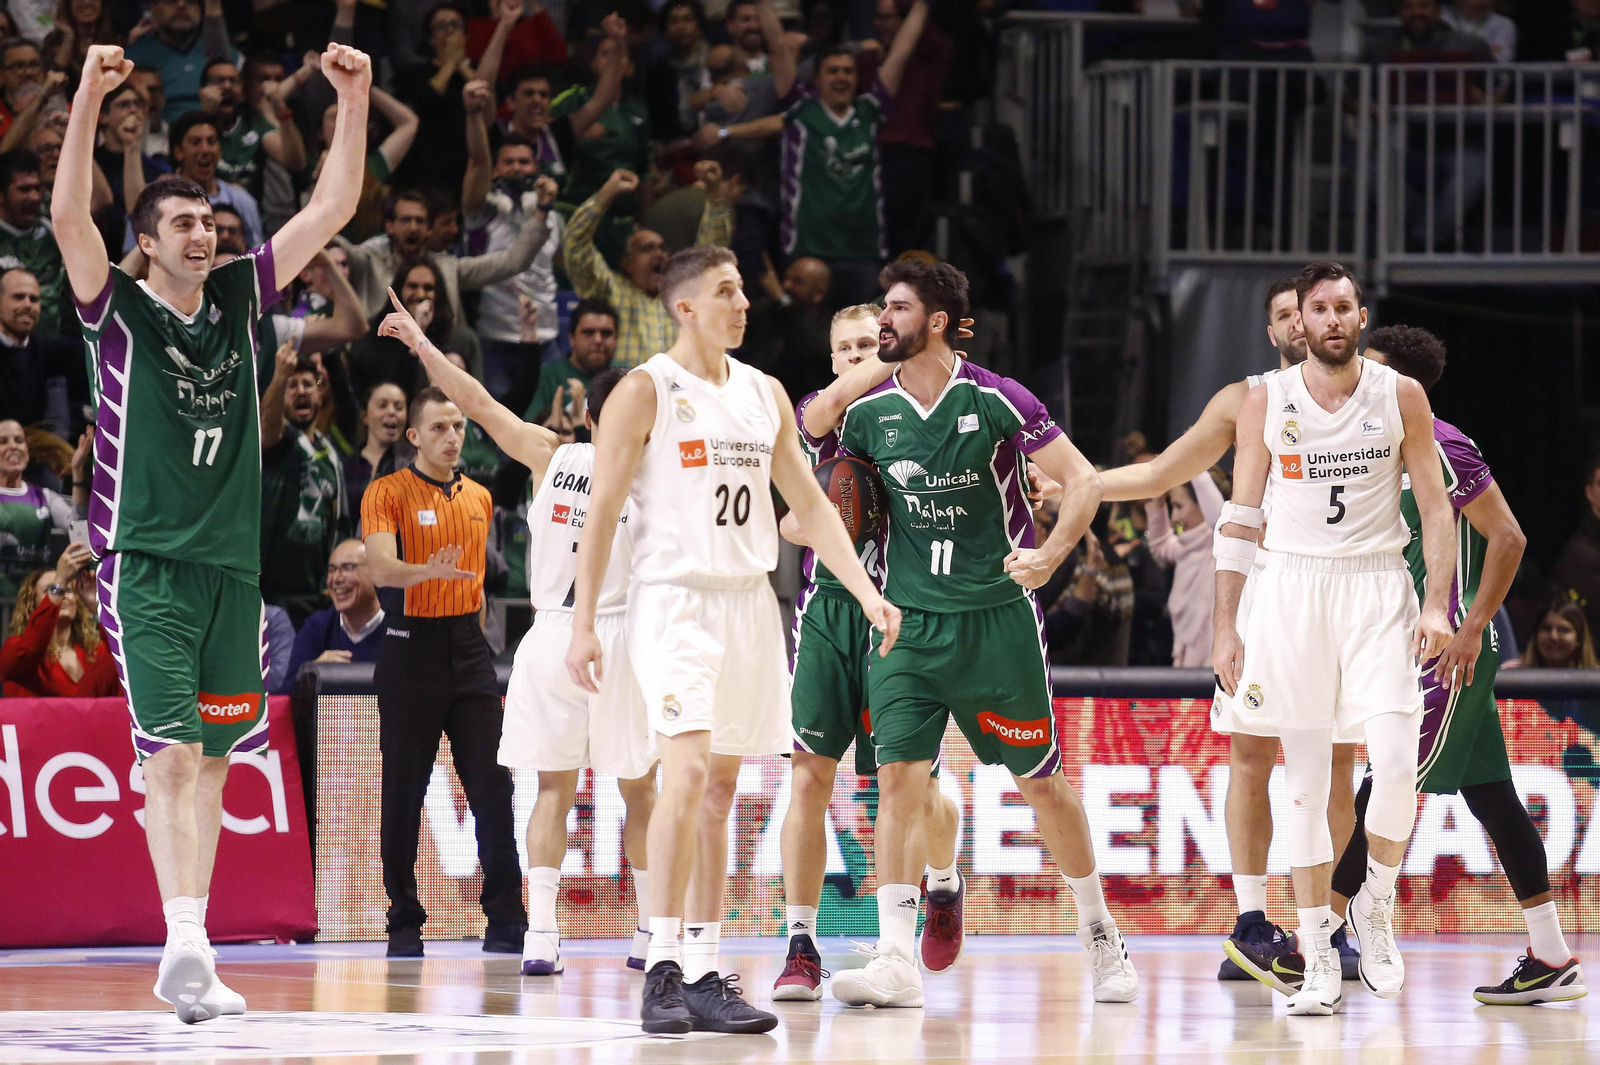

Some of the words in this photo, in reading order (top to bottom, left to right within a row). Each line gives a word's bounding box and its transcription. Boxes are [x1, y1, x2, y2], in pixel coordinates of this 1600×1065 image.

[878, 413, 902, 424] SPALDING
[192, 426, 223, 467] 17
[710, 438, 773, 457] Universida
[1307, 446, 1391, 465] Universidad
[713, 453, 760, 469] Europea
[925, 469, 980, 488] Unicaja
[1308, 465, 1369, 479] Europea
[553, 471, 592, 496] CAM
[715, 483, 751, 526] 20
[903, 494, 969, 527] Málaga
[1326, 485, 1346, 525] 5
[930, 539, 954, 576] 11
[197, 701, 250, 717] worten
[799, 727, 825, 739] SPALDING
[986, 718, 1044, 741] worten
